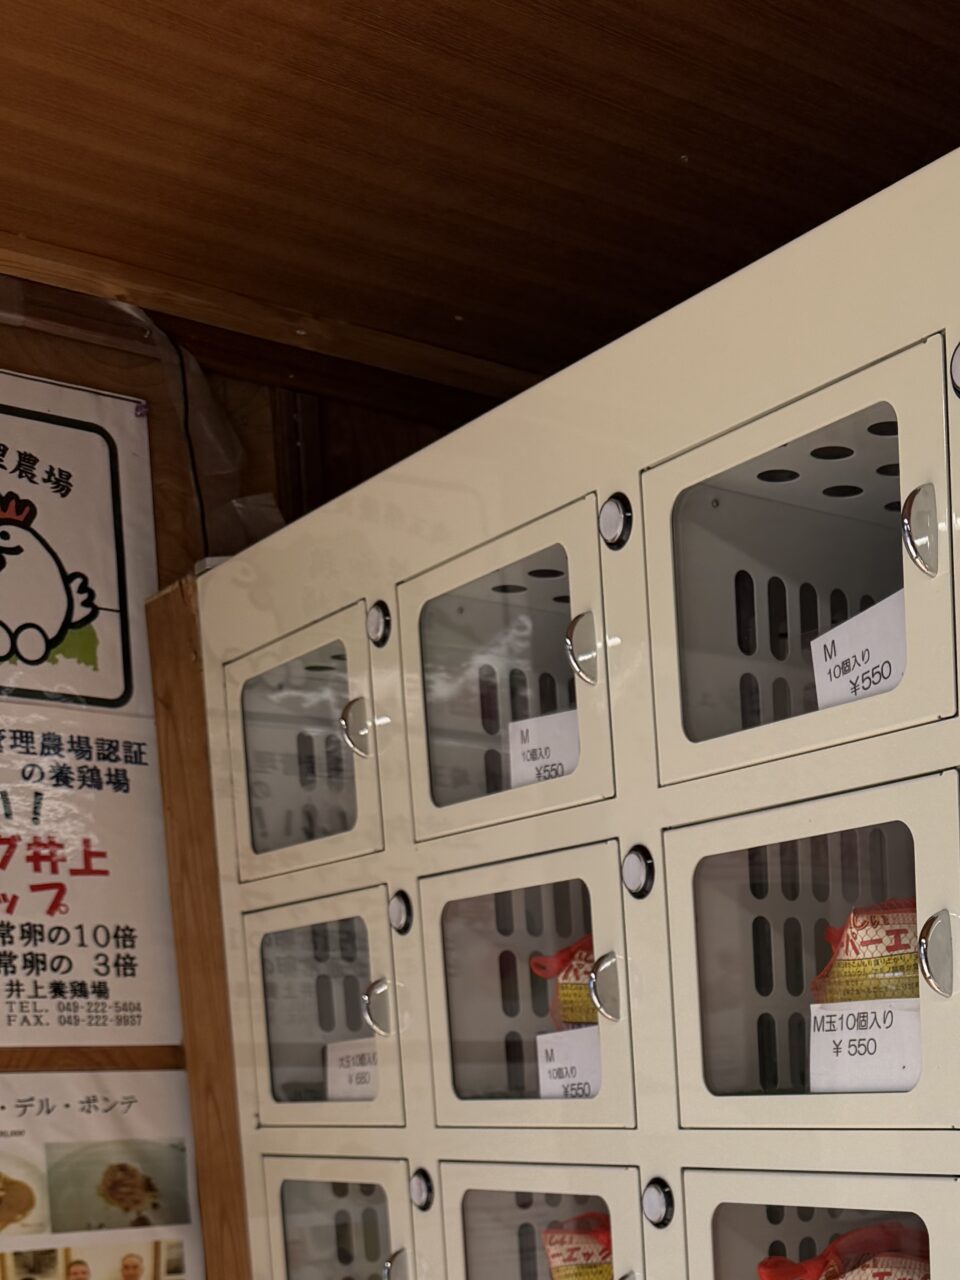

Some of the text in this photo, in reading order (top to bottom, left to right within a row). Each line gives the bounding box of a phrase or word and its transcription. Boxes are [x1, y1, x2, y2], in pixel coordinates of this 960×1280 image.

[823, 640, 837, 663] M
[827, 648, 871, 682] 10個入り
[850, 661, 891, 695] ¥550
[520, 729, 530, 745] M
[21, 763, 131, 794] の養鶏場
[536, 763, 564, 781] ¥550
[0, 920, 138, 950] 常卵の10倍
[4, 979, 110, 1000] 井上養鶏場
[6, 1001, 49, 1013] TEL.
[6, 1014, 50, 1026] FAX.
[812, 1009, 894, 1034] M玉10個入り
[545, 1048, 555, 1062] M
[562, 1082, 591, 1098] ¥550
